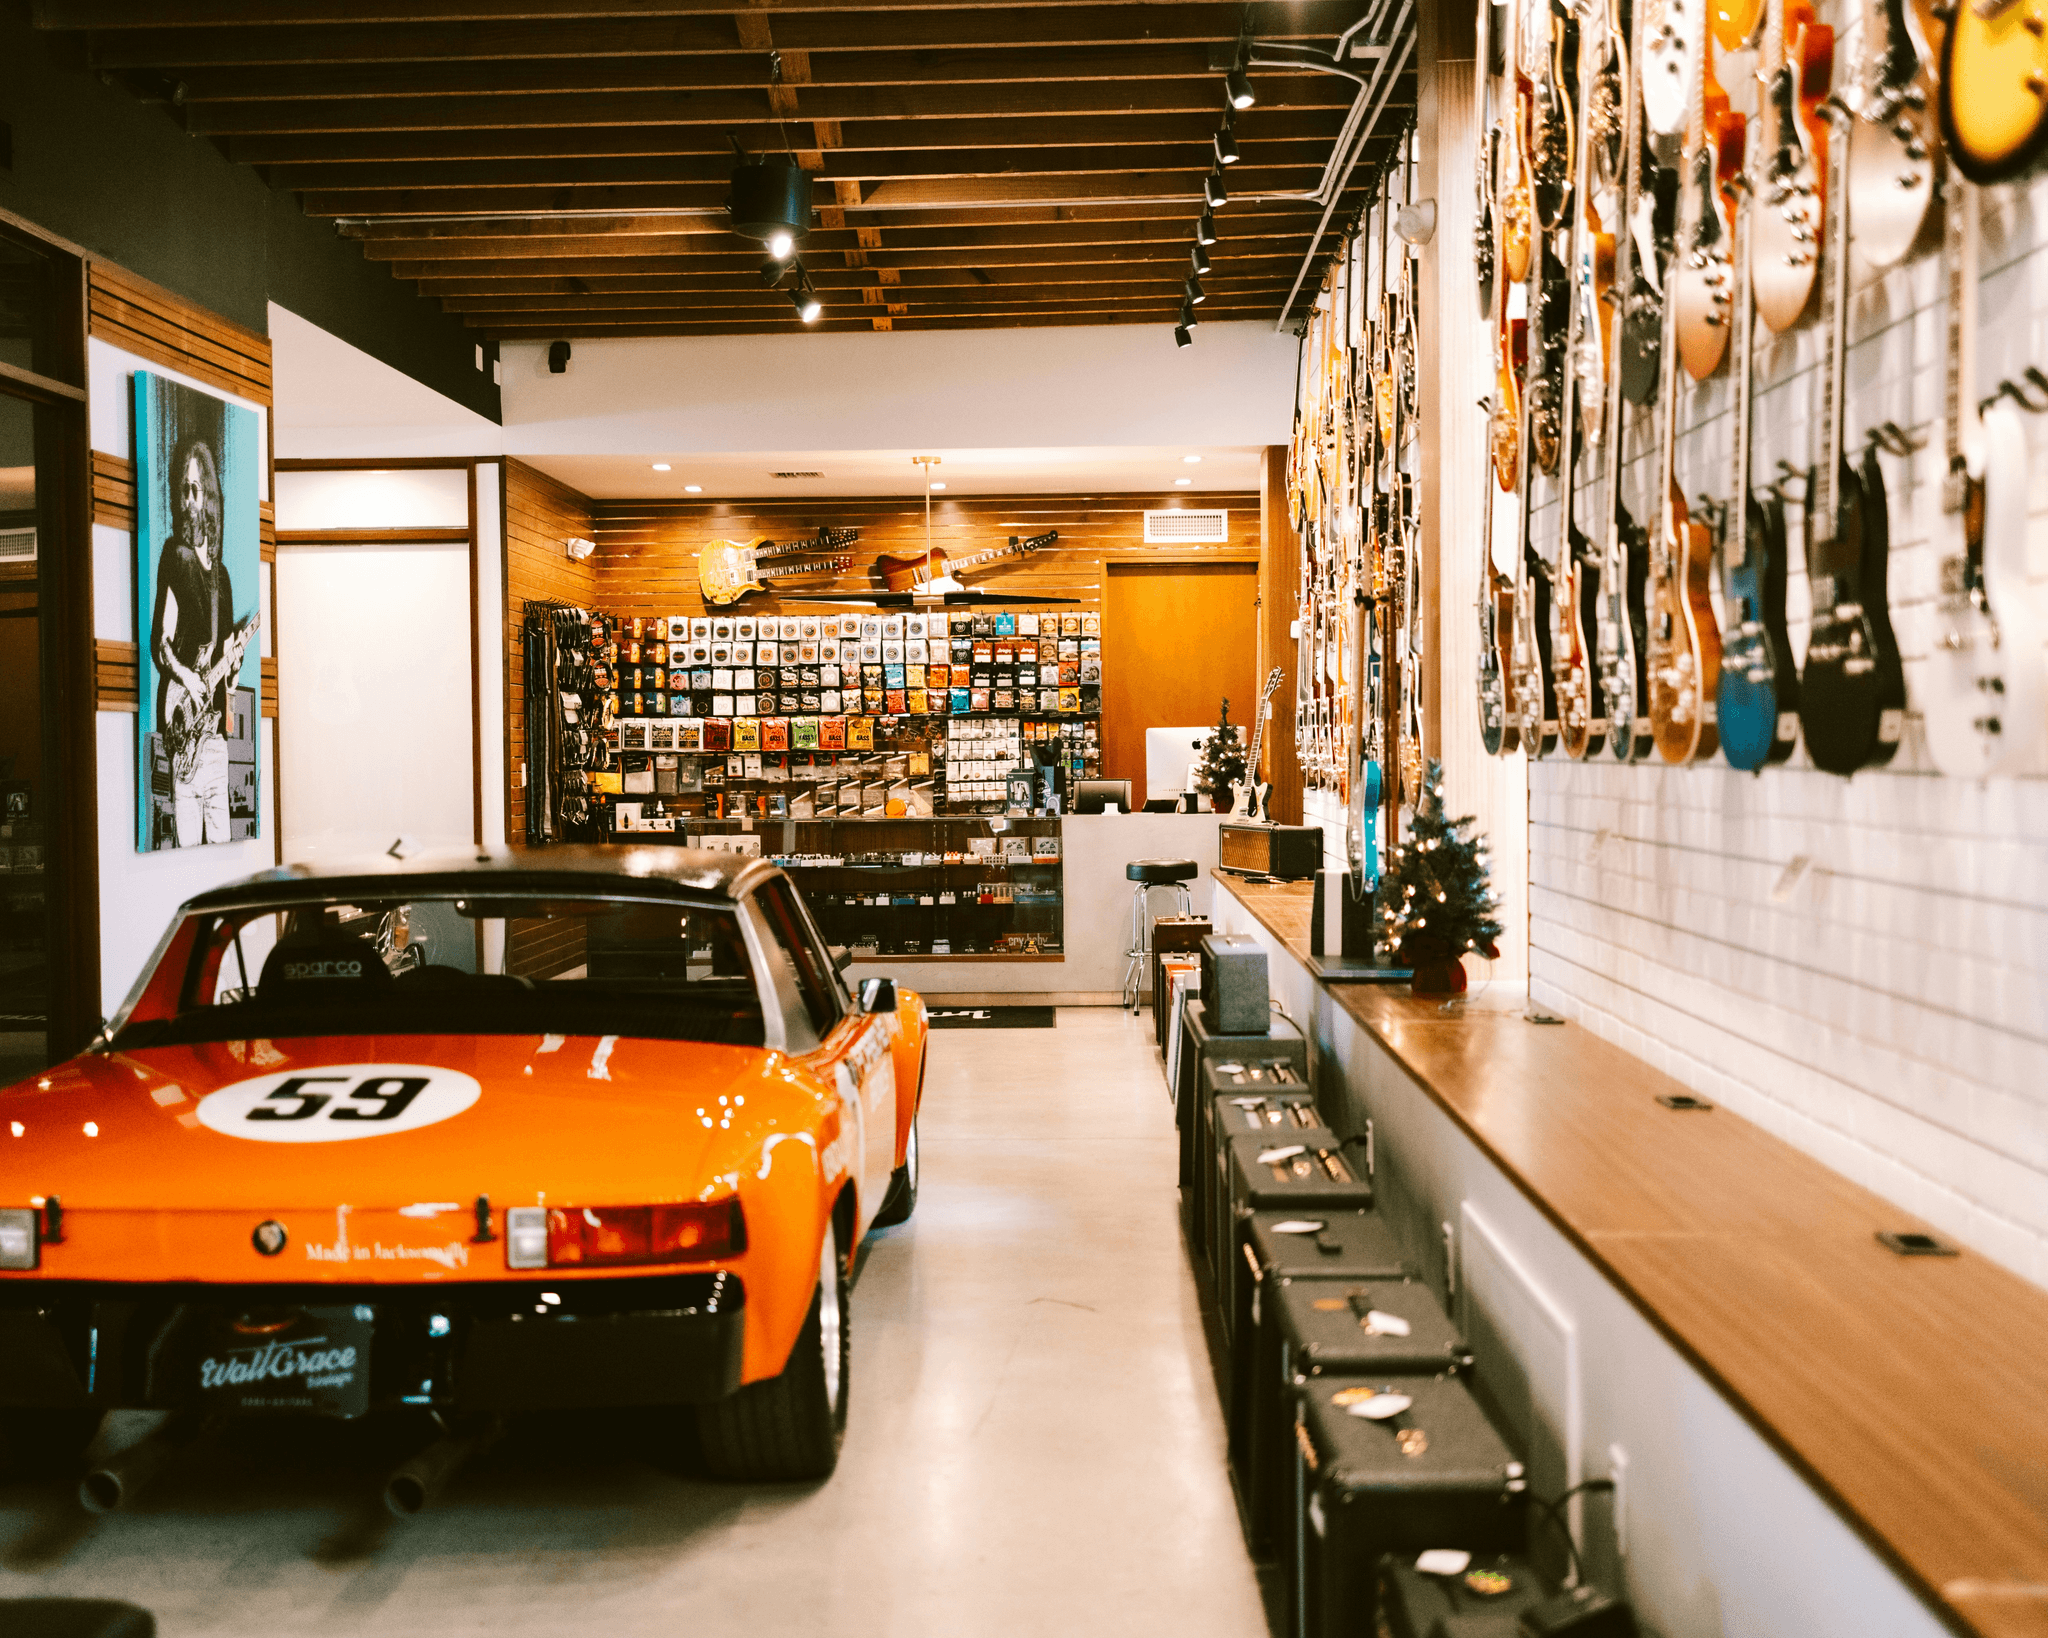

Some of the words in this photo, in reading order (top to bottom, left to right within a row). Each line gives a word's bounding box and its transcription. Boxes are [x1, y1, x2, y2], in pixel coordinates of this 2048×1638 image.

[284, 960, 363, 977] sparco
[244, 1076, 432, 1122] 59
[352, 1243, 371, 1261] in
